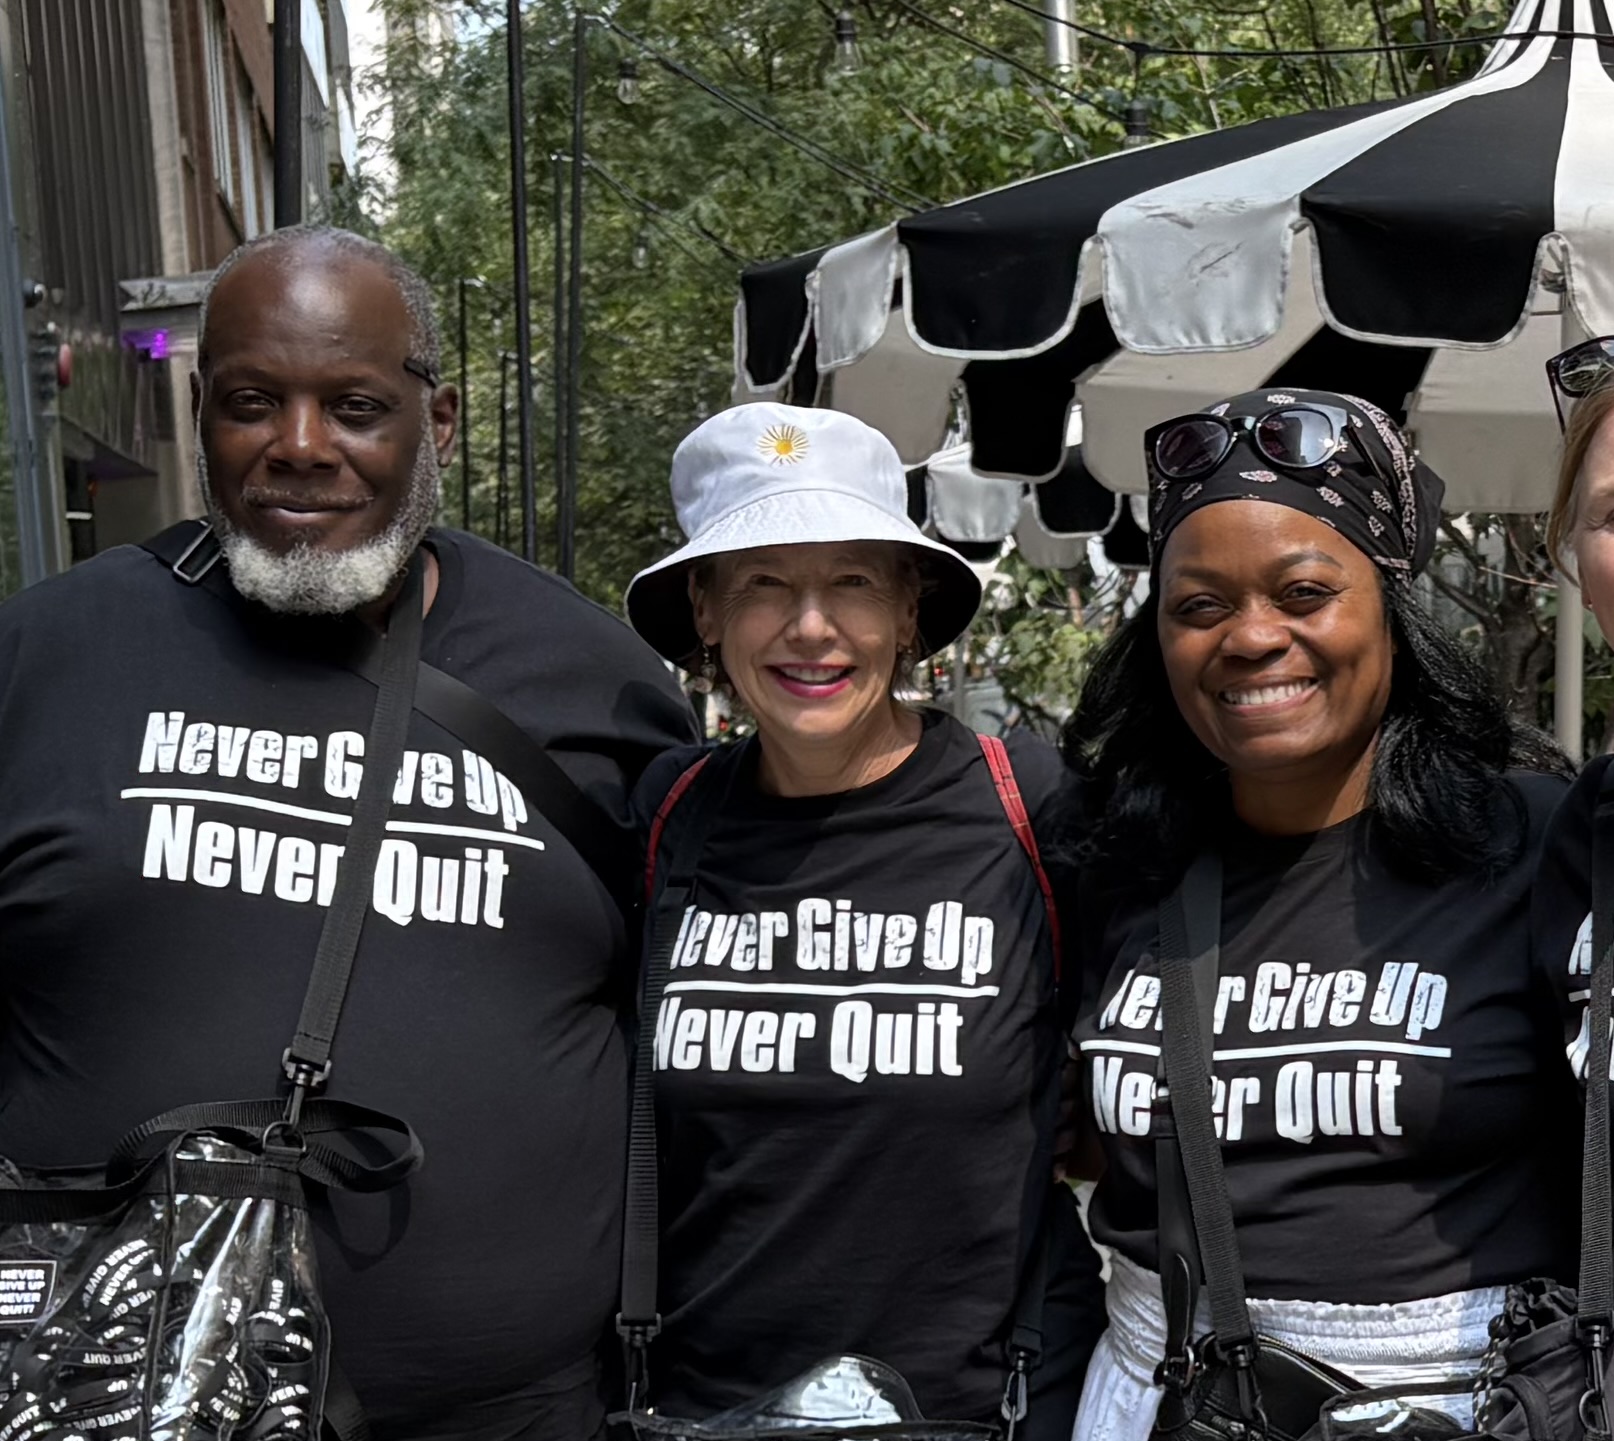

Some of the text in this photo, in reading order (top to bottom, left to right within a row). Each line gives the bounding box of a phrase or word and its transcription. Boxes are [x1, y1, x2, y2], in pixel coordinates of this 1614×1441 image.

[138, 711, 318, 788] Never
[462, 749, 528, 832] Up
[372, 838, 509, 929] Quit
[797, 898, 917, 972] Give
[923, 901, 994, 985] Up
[830, 1000, 963, 1083] Quit
[1248, 962, 1367, 1034] Give
[1369, 962, 1448, 1041] Up
[1275, 1060, 1403, 1144] Quit
[28, 1281, 46, 1290] UP
[99, 1263, 133, 1306] NEVER
